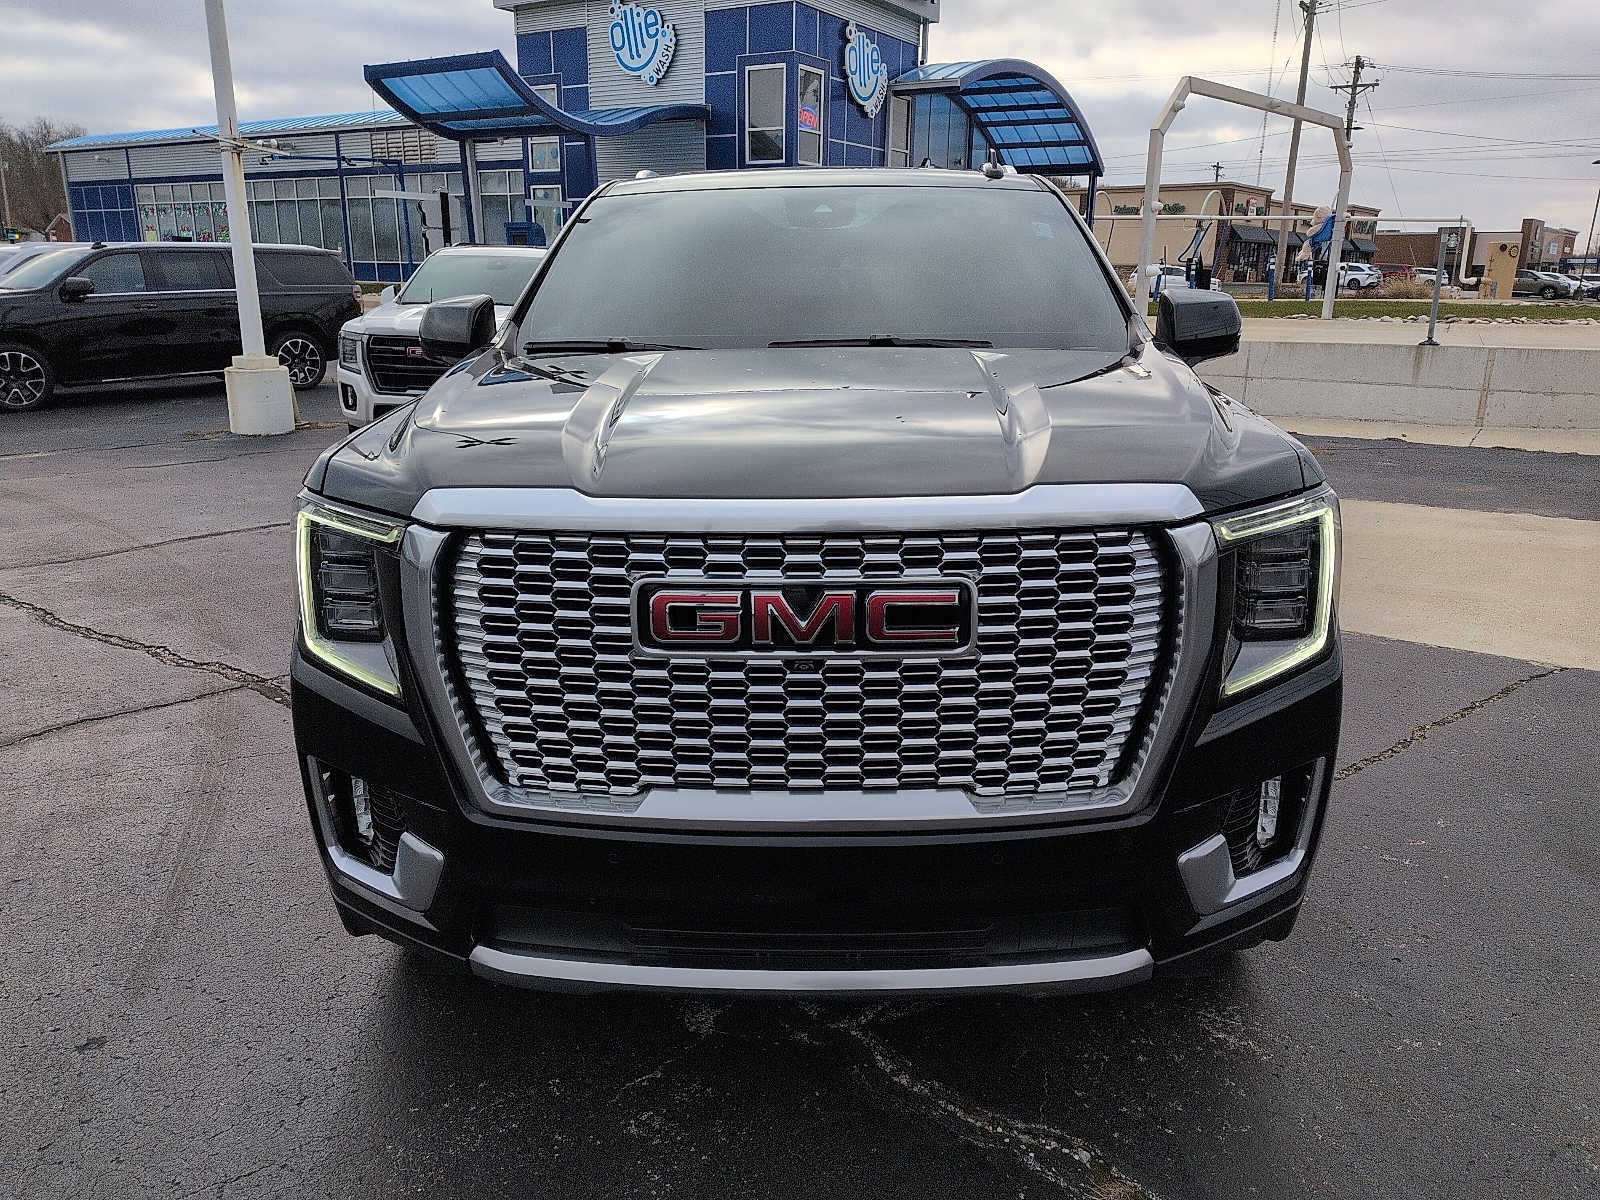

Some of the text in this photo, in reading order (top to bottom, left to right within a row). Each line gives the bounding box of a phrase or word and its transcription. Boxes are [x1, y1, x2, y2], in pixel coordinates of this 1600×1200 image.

[610, 8, 660, 60] ollie
[653, 43, 673, 77] WASH
[848, 34, 880, 88] ollie
[873, 82, 887, 112] WASH
[649, 590, 960, 645] GMC
